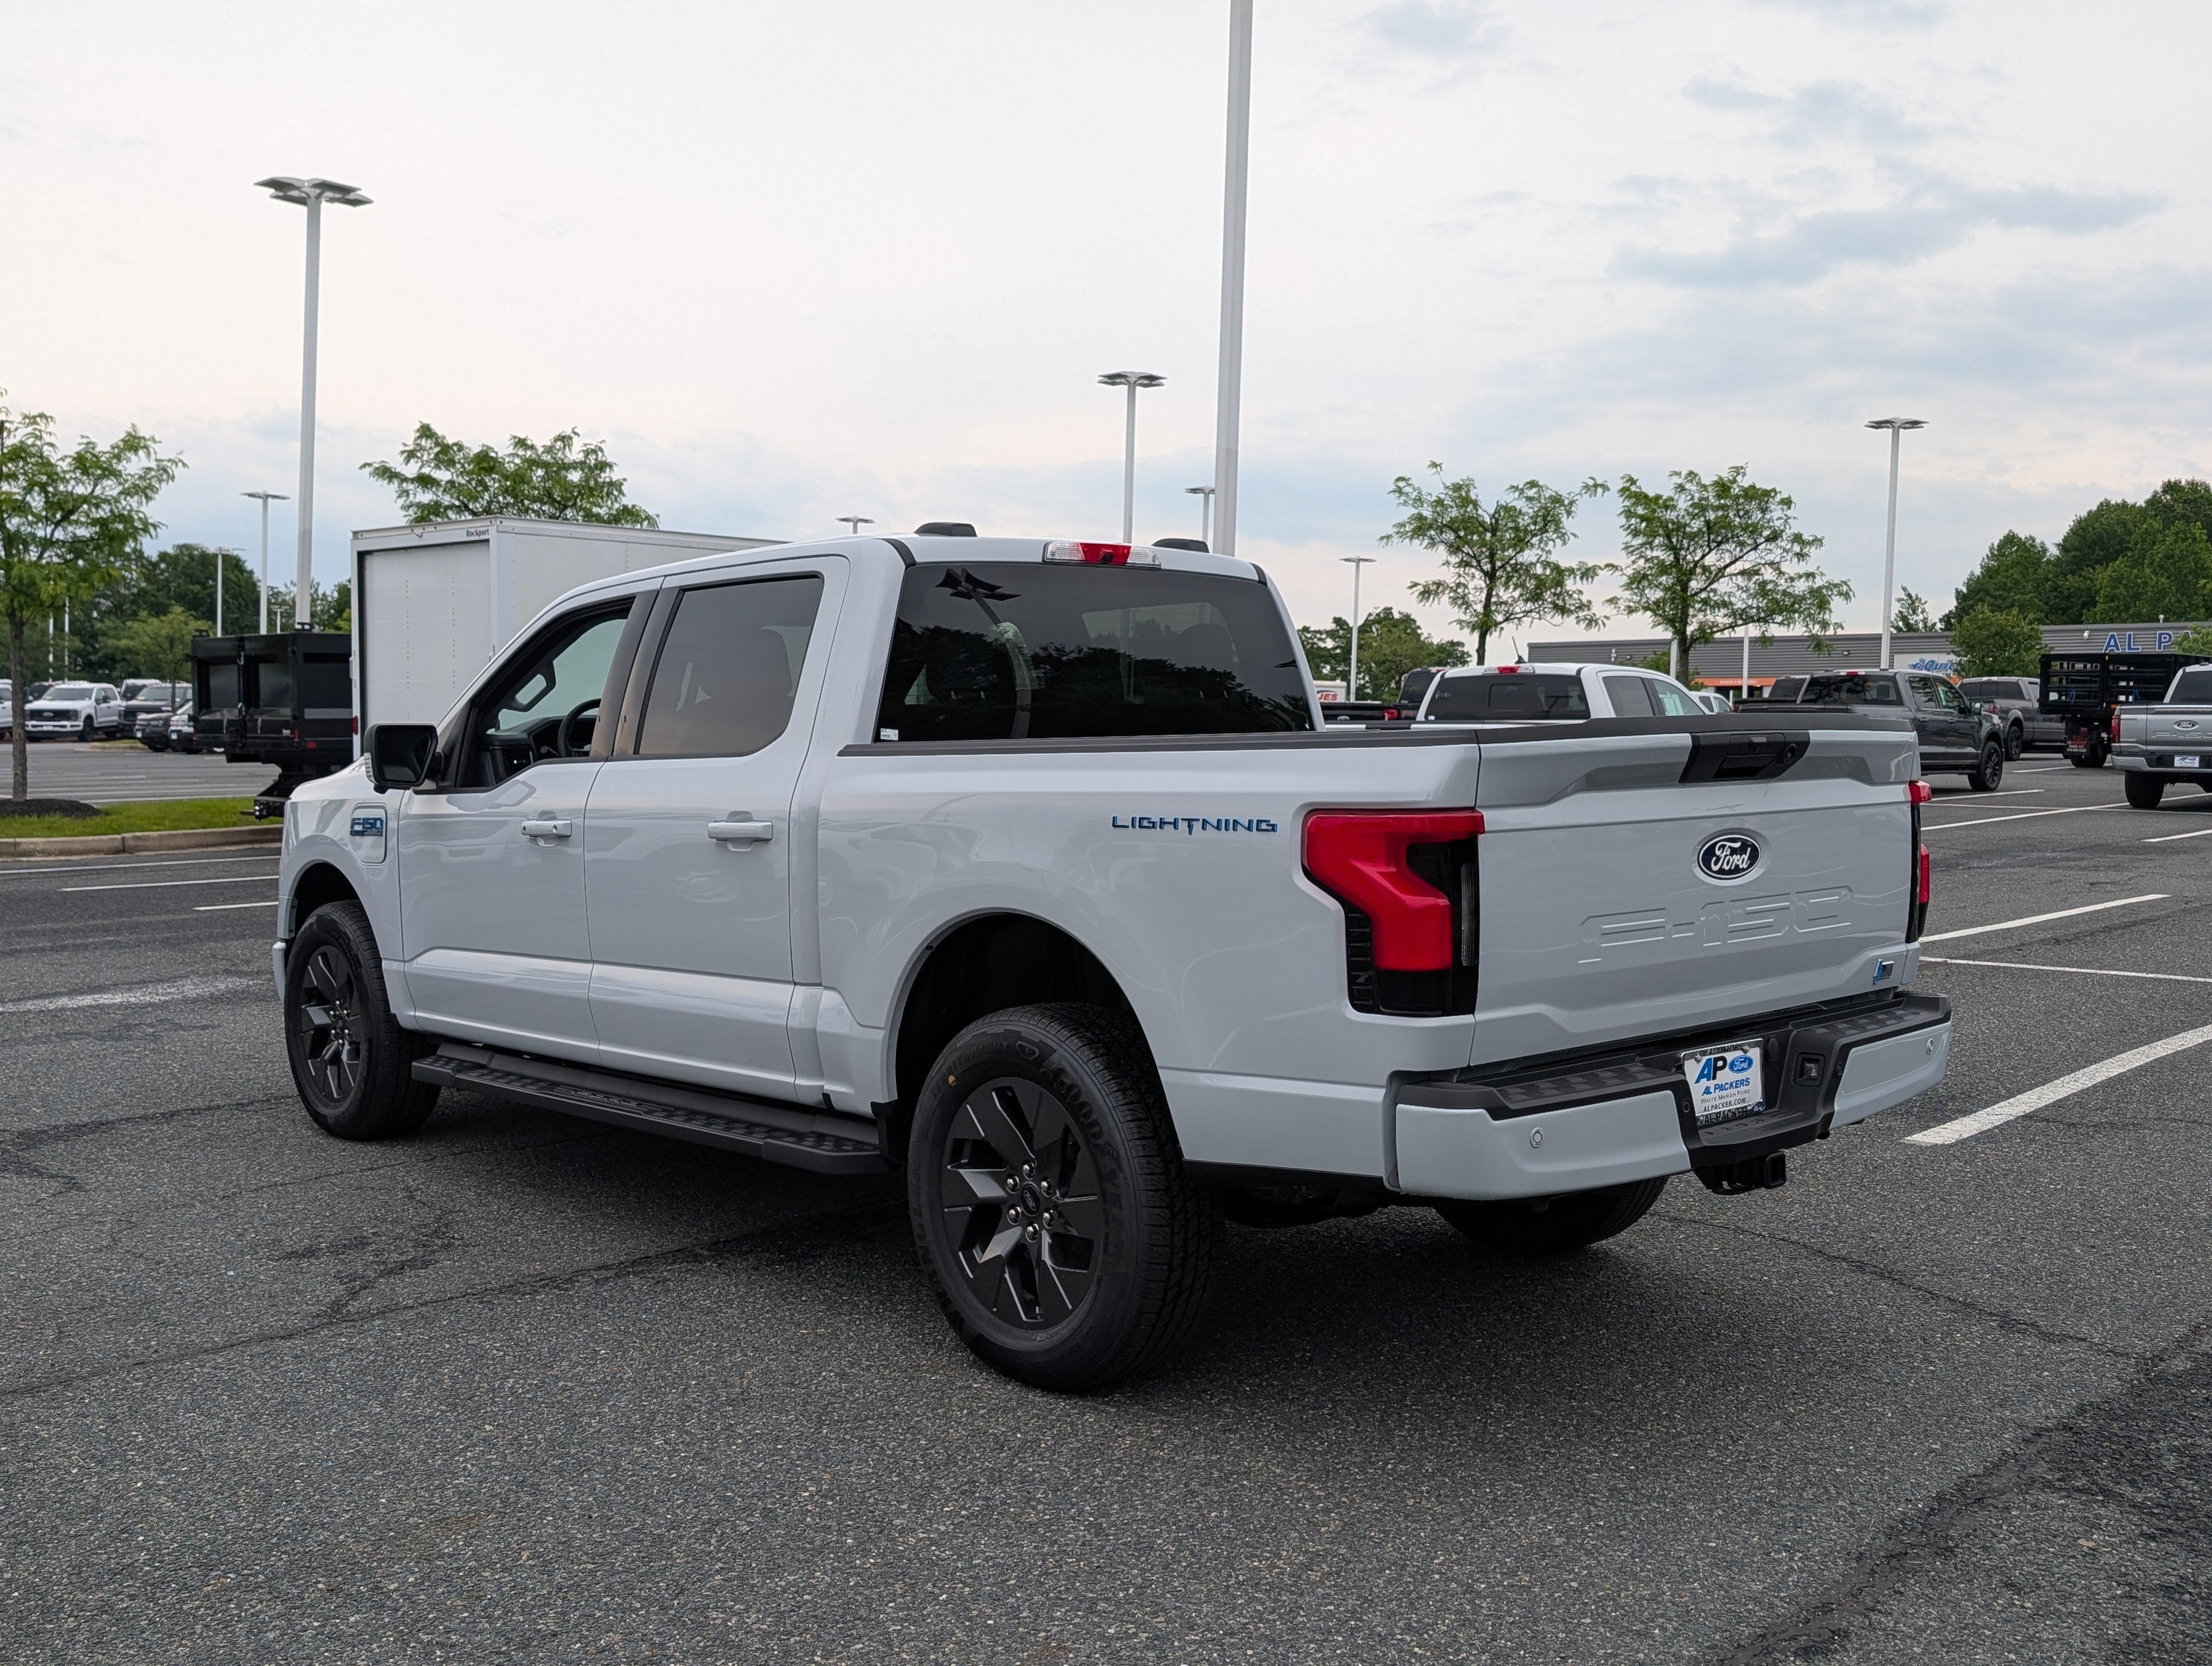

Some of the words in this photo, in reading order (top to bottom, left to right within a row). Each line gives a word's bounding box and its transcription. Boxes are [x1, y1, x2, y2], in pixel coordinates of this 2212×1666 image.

[2102, 626, 2142, 653] AL
[1112, 816, 1278, 836] LIGHTNING
[1711, 841, 1751, 872] Ford
[1578, 885, 1853, 964] F-150
[1694, 1055, 1728, 1085] AP
[1701, 1085, 1713, 1097] AL
[1713, 1076, 1751, 1094] PACKER'S
[1718, 1092, 1737, 1101] MARSH
[1703, 1097, 1746, 1112] ALPACKER.COM
